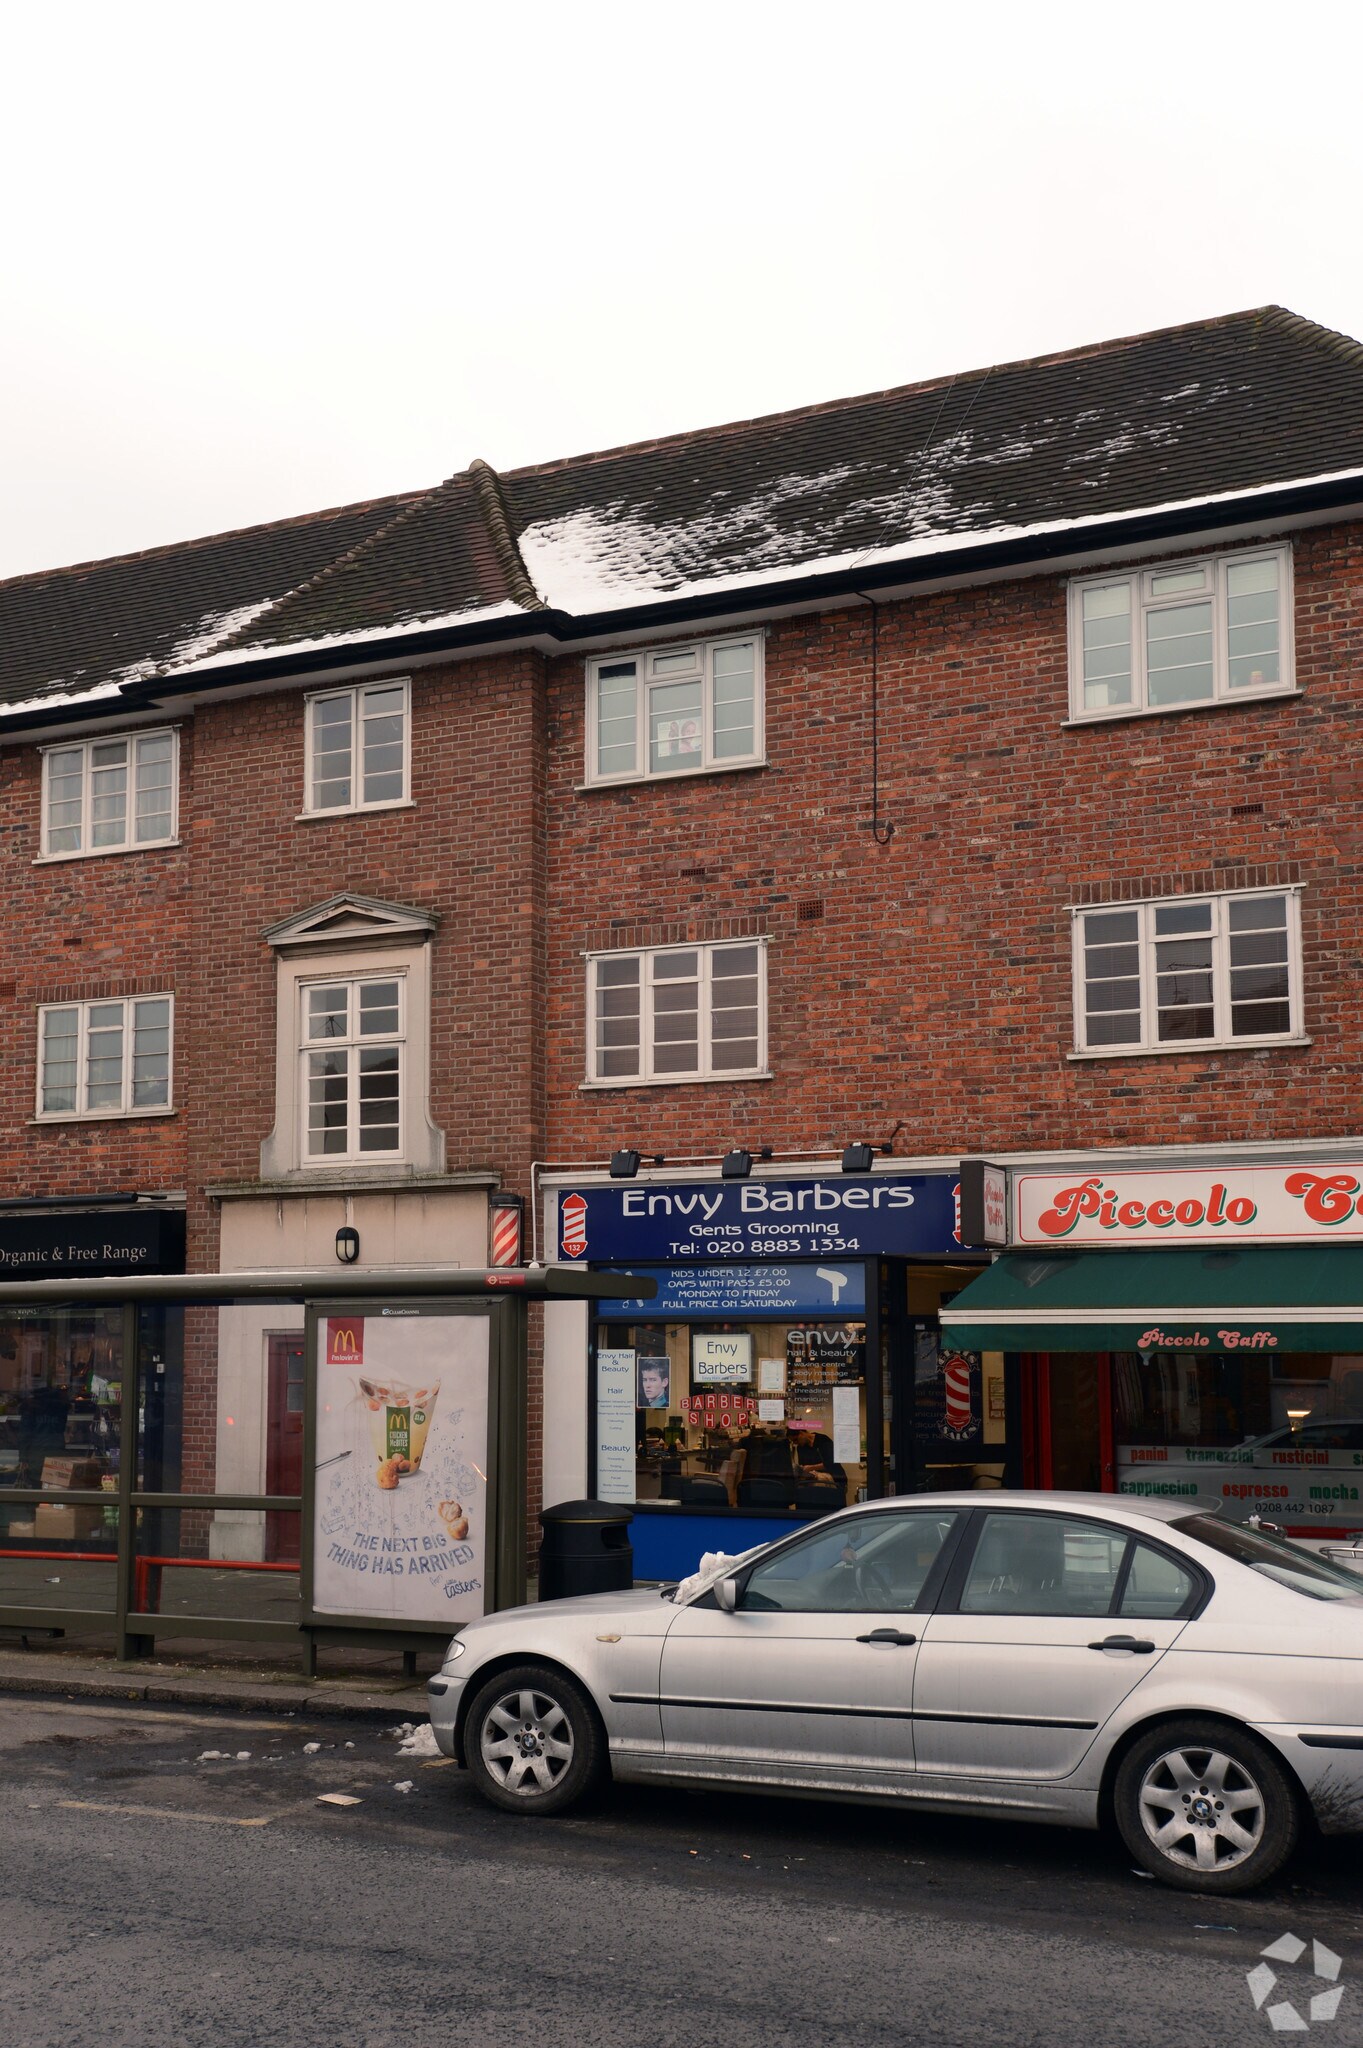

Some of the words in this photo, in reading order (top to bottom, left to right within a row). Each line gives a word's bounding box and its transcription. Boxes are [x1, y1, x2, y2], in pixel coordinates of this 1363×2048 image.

[622, 1190, 723, 1221] Envy
[741, 1183, 915, 1213] Barbers
[1038, 1178, 1257, 1237] Piccolo
[1284, 1172, 1363, 1226] C
[689, 1224, 742, 1237] Gents
[747, 1222, 840, 1235] Grooming
[52, 1246, 63, 1261] &
[68, 1245, 98, 1260] Free
[102, 1244, 147, 1263] Range
[568, 1244, 581, 1252] 132
[669, 1242, 700, 1255] Tel:
[707, 1241, 744, 1254] 020
[751, 1239, 801, 1252] 8883
[810, 1238, 860, 1251] 1334
[671, 1269, 695, 1278] KIDS
[697, 1269, 734, 1277] UNDER
[738, 1269, 751, 1277] 12
[754, 1268, 787, 1277] £7.00
[667, 1279, 697, 1288] OAPS
[699, 1279, 724, 1287] WITH
[727, 1279, 755, 1287] PASS
[757, 1279, 791, 1287] £5.00
[678, 1290, 723, 1298] MONDAY
[725, 1289, 740, 1297] TO
[742, 1289, 781, 1297] FRIDAY
[662, 1300, 686, 1308] FULL
[688, 1300, 718, 1308] PRICE
[721, 1300, 738, 1308] ON
[740, 1299, 797, 1308] SATURDAY
[787, 1331, 857, 1349] envy
[1137, 1328, 1210, 1349] Piccolo
[1217, 1330, 1278, 1349] Caffe
[707, 1341, 738, 1356] Envy
[786, 1349, 806, 1357] hair
[808, 1349, 819, 1357] &
[820, 1349, 857, 1358] beauty
[597, 1353, 617, 1361] Envy
[698, 1362, 748, 1375] Barbers
[794, 1387, 830, 1395] threading
[681, 1395, 755, 1410] BARBER
[689, 1412, 748, 1428] SHOP
[1130, 1448, 1168, 1463] panini
[1186, 1447, 1254, 1464] tramezzini
[1272, 1449, 1330, 1465] rusticini
[1120, 1480, 1198, 1497] cappuccino
[1222, 1483, 1289, 1500] espresso
[1309, 1483, 1359, 1500] mocha
[1255, 1503, 1282, 1513] 0208
[1285, 1504, 1304, 1513] 442
[1308, 1504, 1335, 1514] 1087
[353, 1532, 380, 1551] THE
[381, 1537, 419, 1552] NEXT
[422, 1533, 447, 1551] BIG
[327, 1542, 369, 1572] THING
[372, 1555, 404, 1575] HAS
[408, 1544, 475, 1575] ARRIVED
